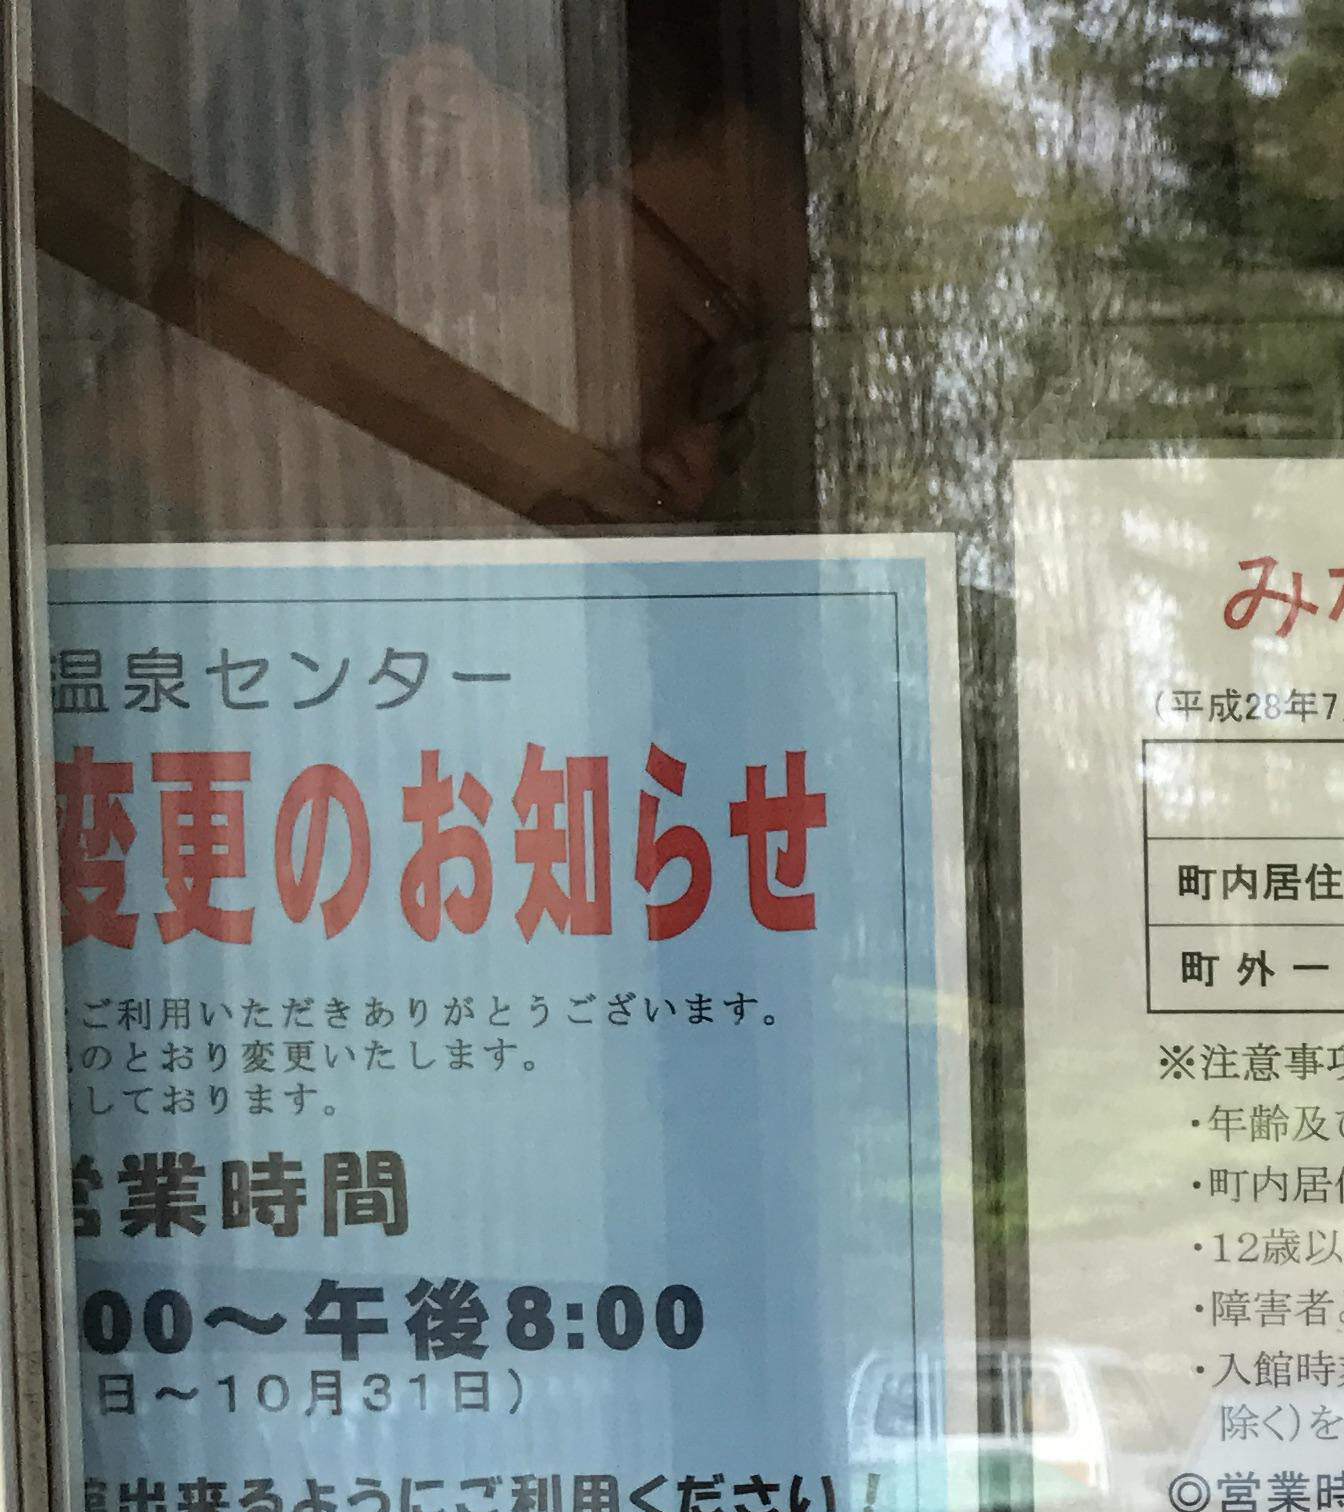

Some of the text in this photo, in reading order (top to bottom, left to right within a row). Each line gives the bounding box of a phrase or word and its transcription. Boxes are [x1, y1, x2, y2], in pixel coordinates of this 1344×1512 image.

[50, 646, 513, 713] 温泉センター
[54, 741, 828, 951] 変更のお知らせ
[64, 994, 779, 1030] ご利用いただきありがとうございます。
[66, 1038, 540, 1073] のとおり変更いたします。
[69, 1081, 341, 1117] しております。
